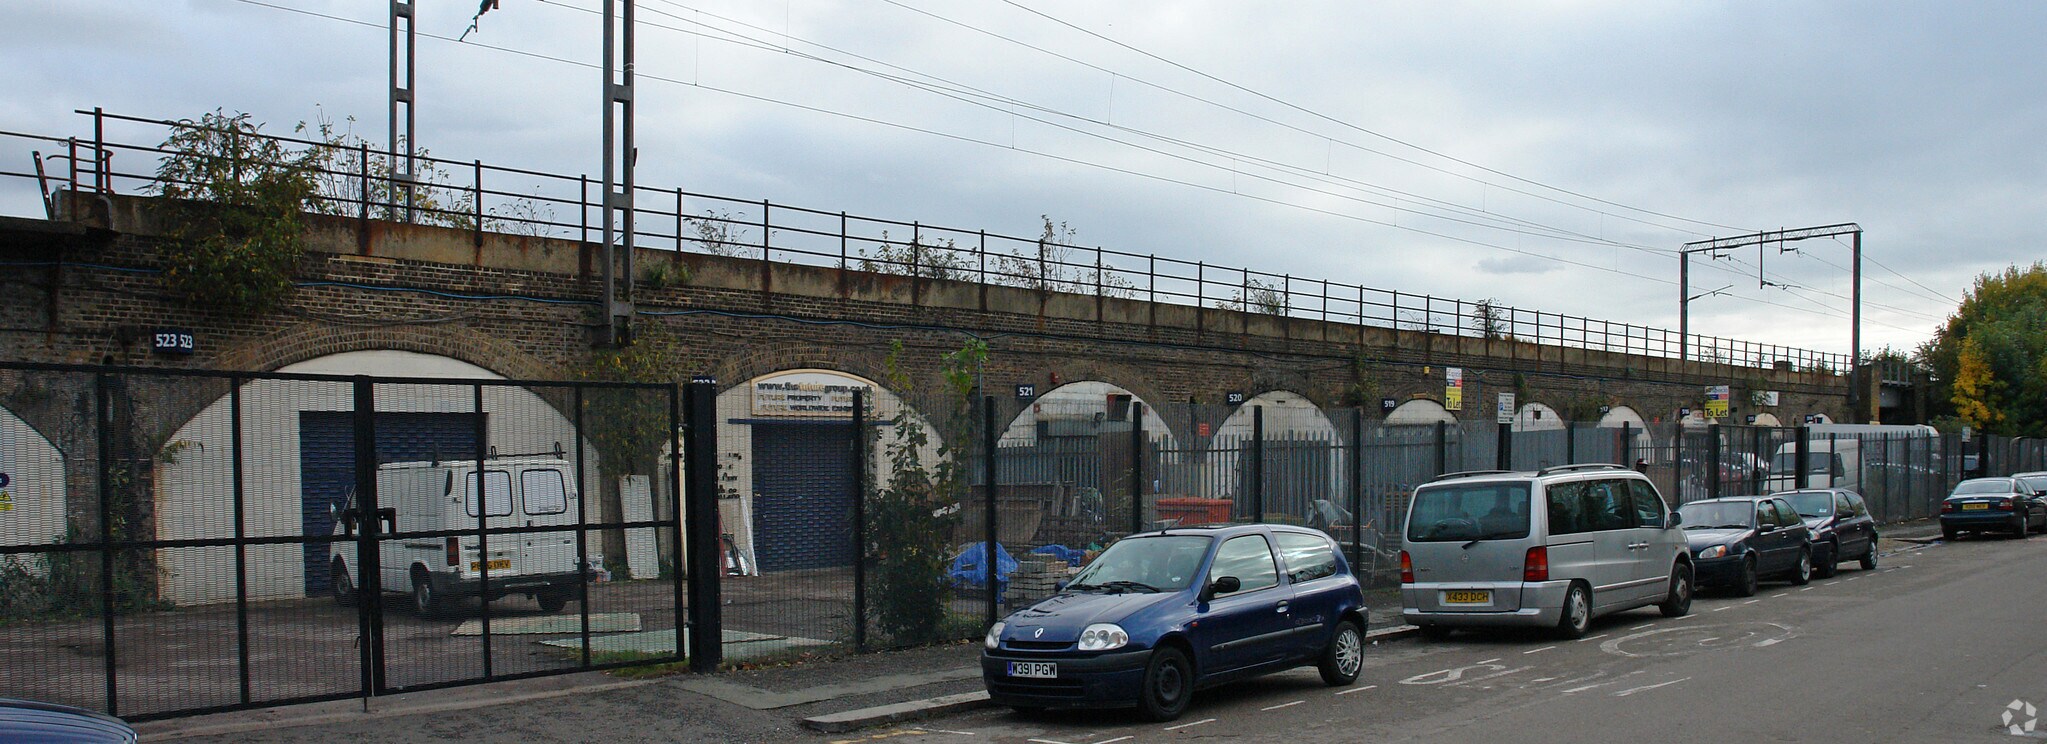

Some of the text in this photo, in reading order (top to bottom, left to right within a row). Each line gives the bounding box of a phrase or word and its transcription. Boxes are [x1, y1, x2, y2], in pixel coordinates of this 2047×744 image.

[156, 333, 193, 349] 523 523
[757, 381, 873, 394] www.thefuturegroup.couk
[1019, 386, 1033, 396] 521
[787, 394, 823, 402] PROPERTY
[1228, 393, 1243, 402] 520
[1384, 400, 1395, 408] 519
[1446, 397, 1453, 409] To
[789, 404, 830, 412] WORLDWIDE
[1705, 408, 1714, 417] To
[1715, 408, 1728, 417] Let
[1447, 592, 1469, 601] X433
[1012, 663, 1056, 676] W391 PGW
